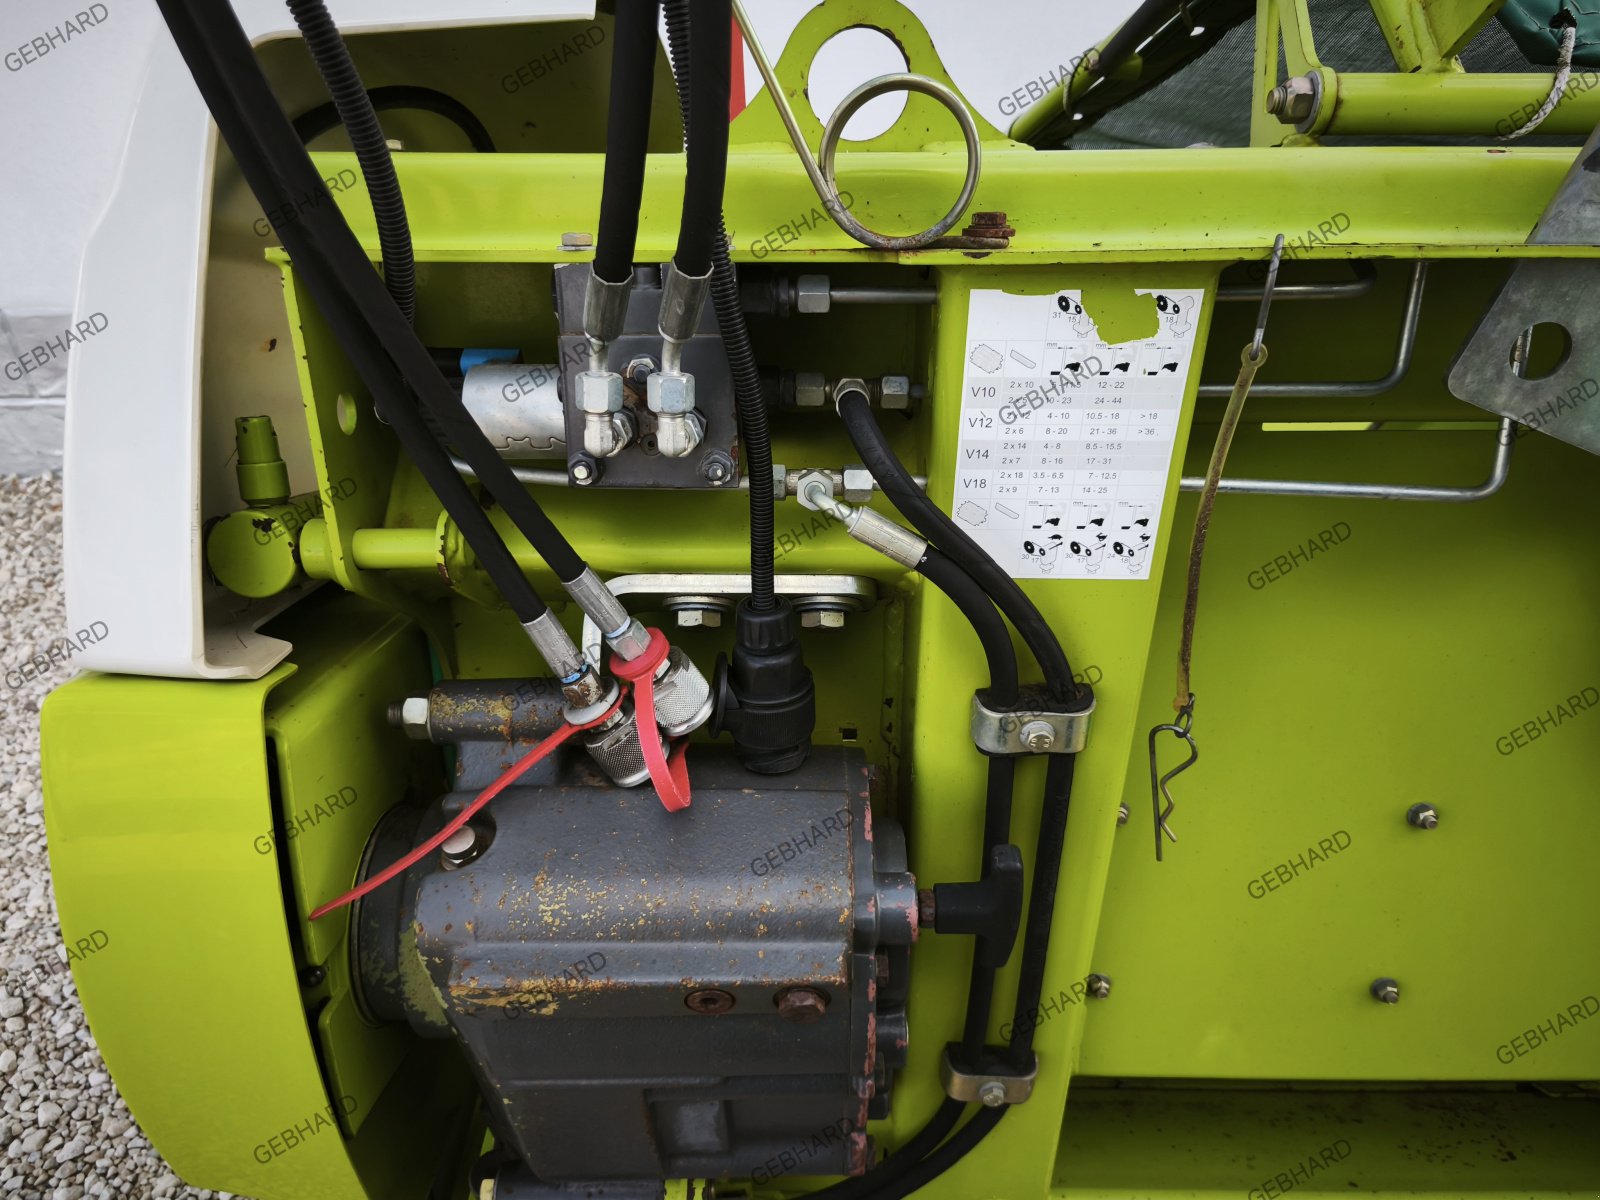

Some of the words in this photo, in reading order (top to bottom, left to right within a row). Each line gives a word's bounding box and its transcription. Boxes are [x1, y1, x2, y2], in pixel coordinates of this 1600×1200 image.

[1052, 311, 1062, 319] 31
[1068, 315, 1076, 323] 15
[1165, 316, 1174, 324] 18
[1009, 381, 1016, 389] 2
[1024, 381, 1034, 389] 10
[1098, 381, 1108, 389] 12
[1114, 381, 1125, 389] 22
[971, 386, 996, 398] V10
[1008, 396, 1014, 404] 2
[1045, 396, 1055, 405] 10
[1061, 397, 1072, 405] 23
[1094, 397, 1105, 405] 24
[1047, 412, 1053, 420] 4
[1060, 412, 1070, 420] 10
[1086, 412, 1103, 420] 10.5
[1111, 412, 1120, 420] 18
[1148, 412, 1158, 420] 18
[968, 417, 993, 428] V12
[1004, 427, 1011, 435] 2
[1018, 427, 1024, 435] 6
[1045, 427, 1051, 435] 8
[1057, 427, 1068, 435] 20
[1089, 427, 1100, 436] 21
[1106, 427, 1117, 436] 36
[1144, 428, 1155, 436] 36
[1003, 442, 1009, 450] 2
[1017, 442, 1027, 450] 14
[1043, 442, 1049, 450] 4
[1055, 442, 1061, 450] 8
[1085, 442, 1098, 450] 8.5
[1106, 442, 1122, 450] 15.5
[965, 449, 989, 460] V14
[1001, 457, 1008, 465] 2
[1041, 457, 1047, 465] 8
[1054, 457, 1064, 465] 16
[1087, 457, 1096, 465] 17
[1102, 457, 1112, 465] 31
[1000, 471, 1006, 479] 2
[1014, 471, 1024, 479] 18
[1032, 471, 1045, 479] 3.5
[1101, 472, 1117, 480] 12.5
[963, 478, 987, 489] V18
[1050, 486, 1060, 494] 13
